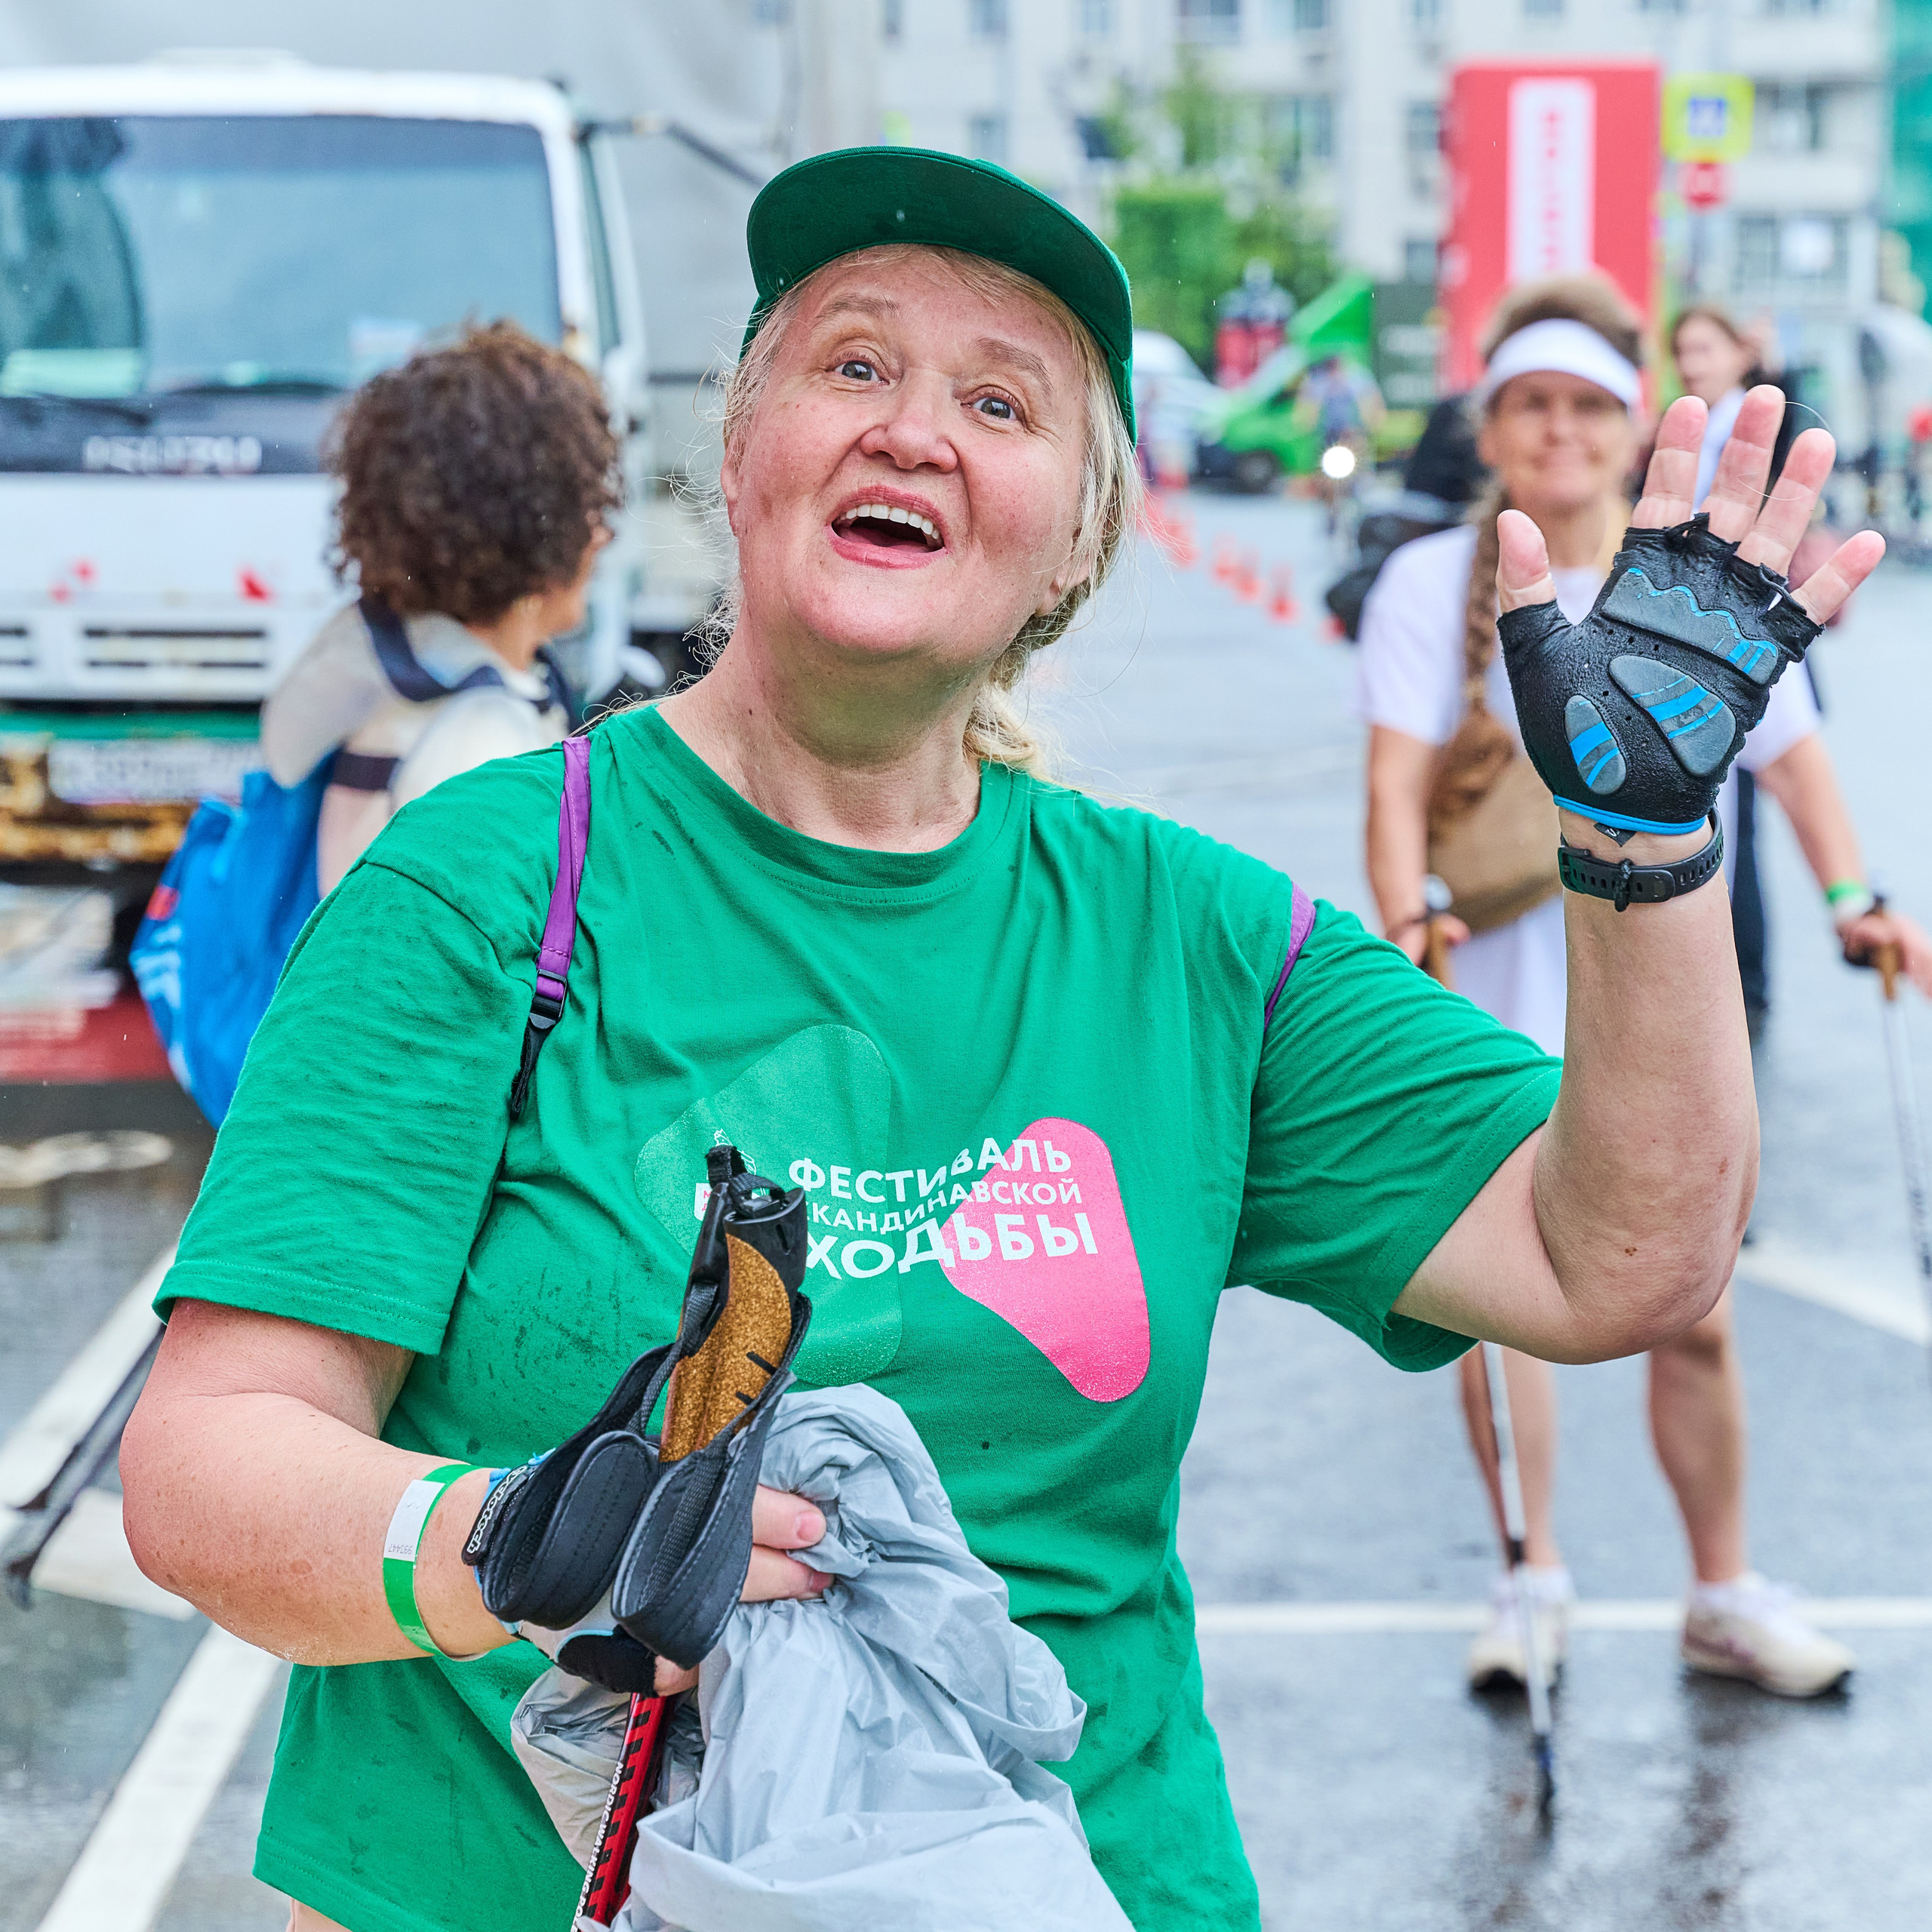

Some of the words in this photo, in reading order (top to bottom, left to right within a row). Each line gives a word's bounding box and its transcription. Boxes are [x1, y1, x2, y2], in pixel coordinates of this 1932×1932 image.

[789, 1138, 1072, 1203] ФЕСТИВАЛЬ
[805, 1178, 1082, 1235] КАНДИНАВСКОЙ
[805, 1213, 1098, 1280] ХОДЬБЫ
[602, 1761, 624, 1822] NORDIC
[582, 1824, 607, 1894] WALKING
